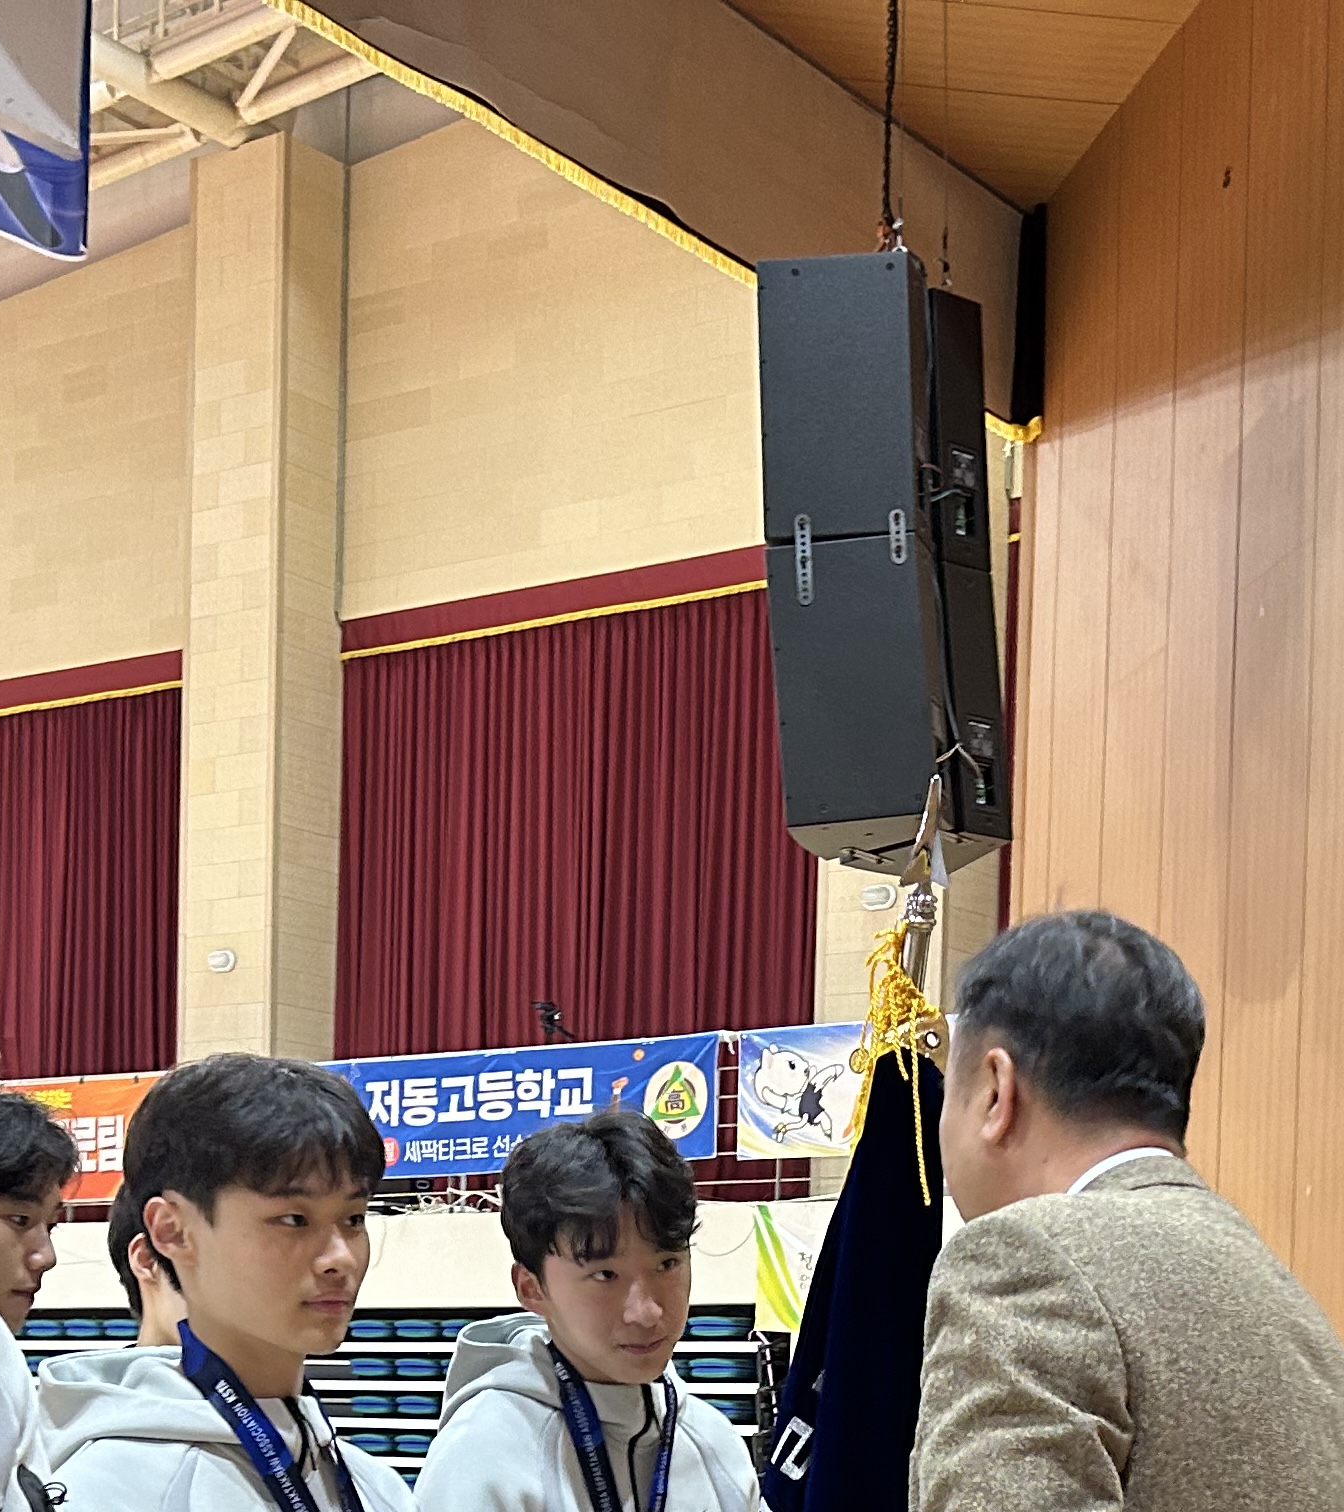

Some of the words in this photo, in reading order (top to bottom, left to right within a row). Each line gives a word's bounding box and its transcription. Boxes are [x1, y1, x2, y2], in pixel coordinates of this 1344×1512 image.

[365, 1067, 594, 1128] 저동고등학교
[403, 1136, 490, 1163] 세팍타크로
[213, 1377, 238, 1403] KSTA
[232, 1400, 277, 1458] ASSOCIATION
